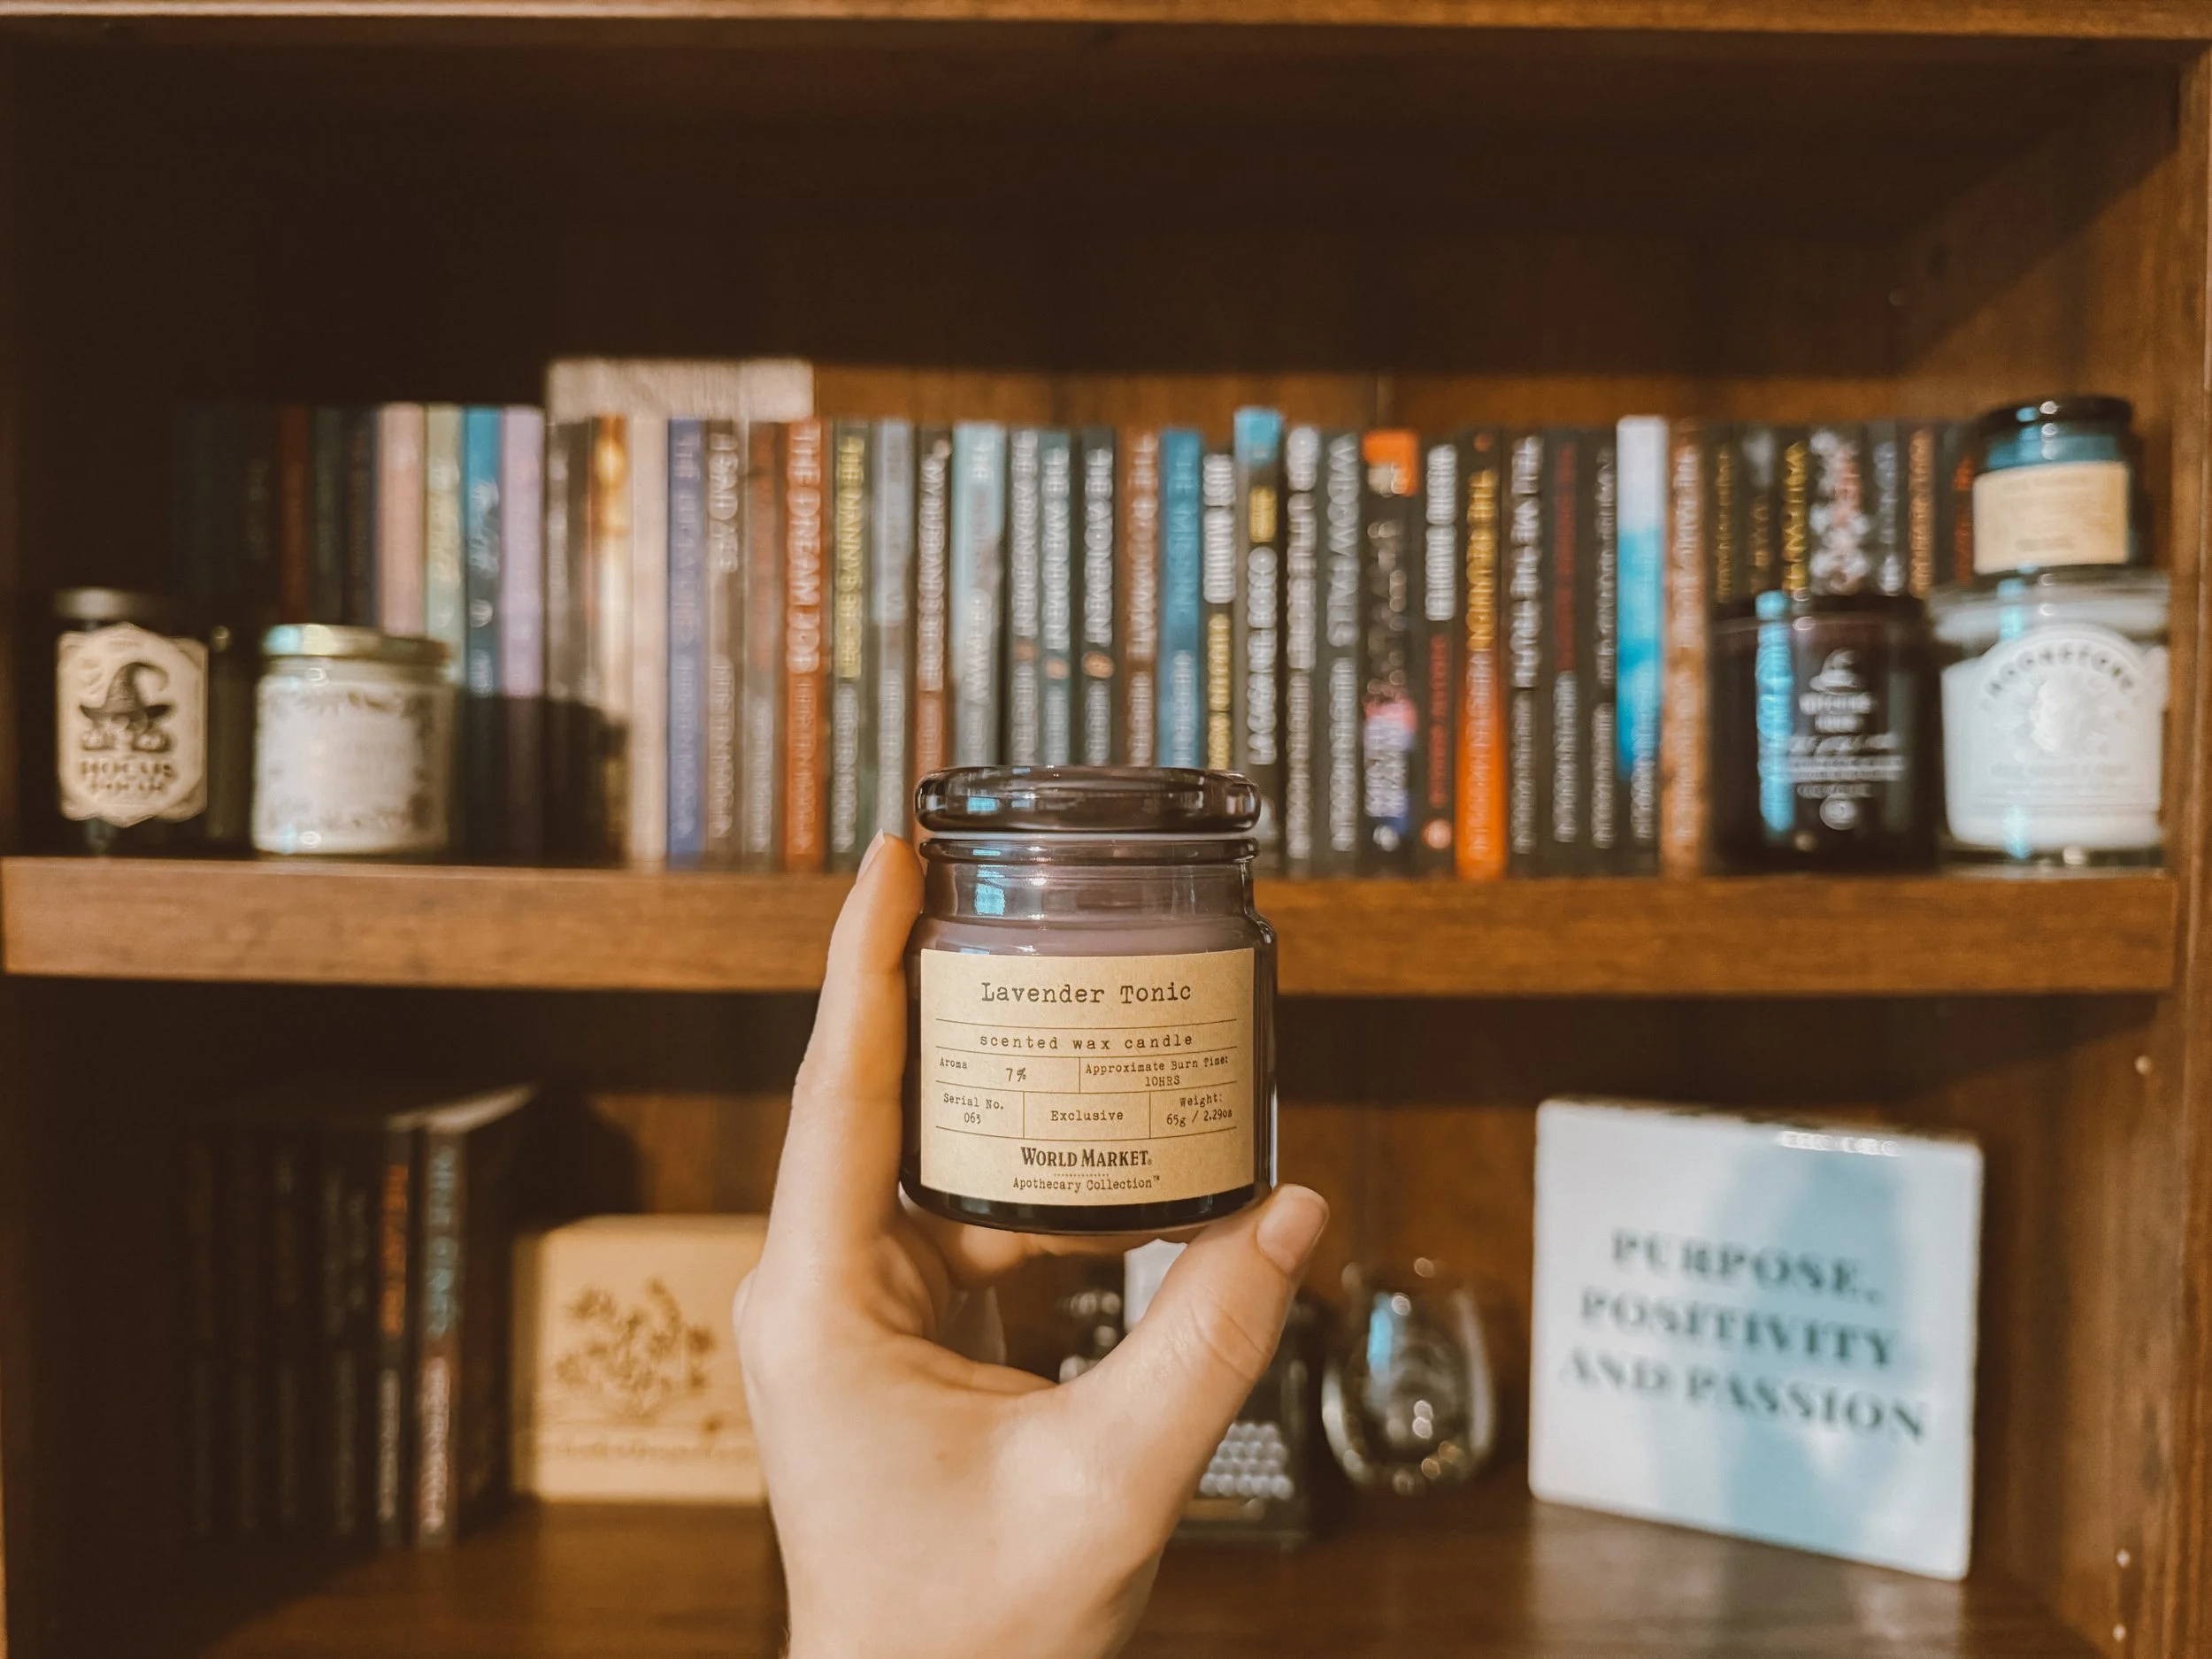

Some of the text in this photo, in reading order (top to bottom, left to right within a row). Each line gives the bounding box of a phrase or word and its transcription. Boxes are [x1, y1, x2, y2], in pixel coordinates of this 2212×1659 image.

[787, 421, 821, 486] THE
[1327, 432, 1360, 557] WIDOW
[787, 486, 821, 605] DREAM
[1327, 557, 1360, 648] FALLS
[980, 981, 1192, 1004] Lavender Tonic
[979, 1033, 1193, 1050] scented wax candle
[940, 1056, 968, 1070] Aroma
[1085, 1056, 1229, 1076] Approximate Burn Time:
[1005, 1067, 1027, 1083] 7%
[1145, 1075, 1180, 1087] 10HRS
[943, 1093, 1004, 1110] Serial No.
[1179, 1094, 1223, 1109] Weight:
[1050, 1110, 1124, 1122] Exclusive
[1166, 1112, 1187, 1127] 65g
[1192, 1110, 1199, 1124] /
[1020, 1146, 1078, 1167] WORLD
[1012, 1177, 1081, 1194] Apothecary
[1580, 1287, 1894, 1369] POSITIVITY
[1560, 1347, 1925, 1442] AND PASSION
